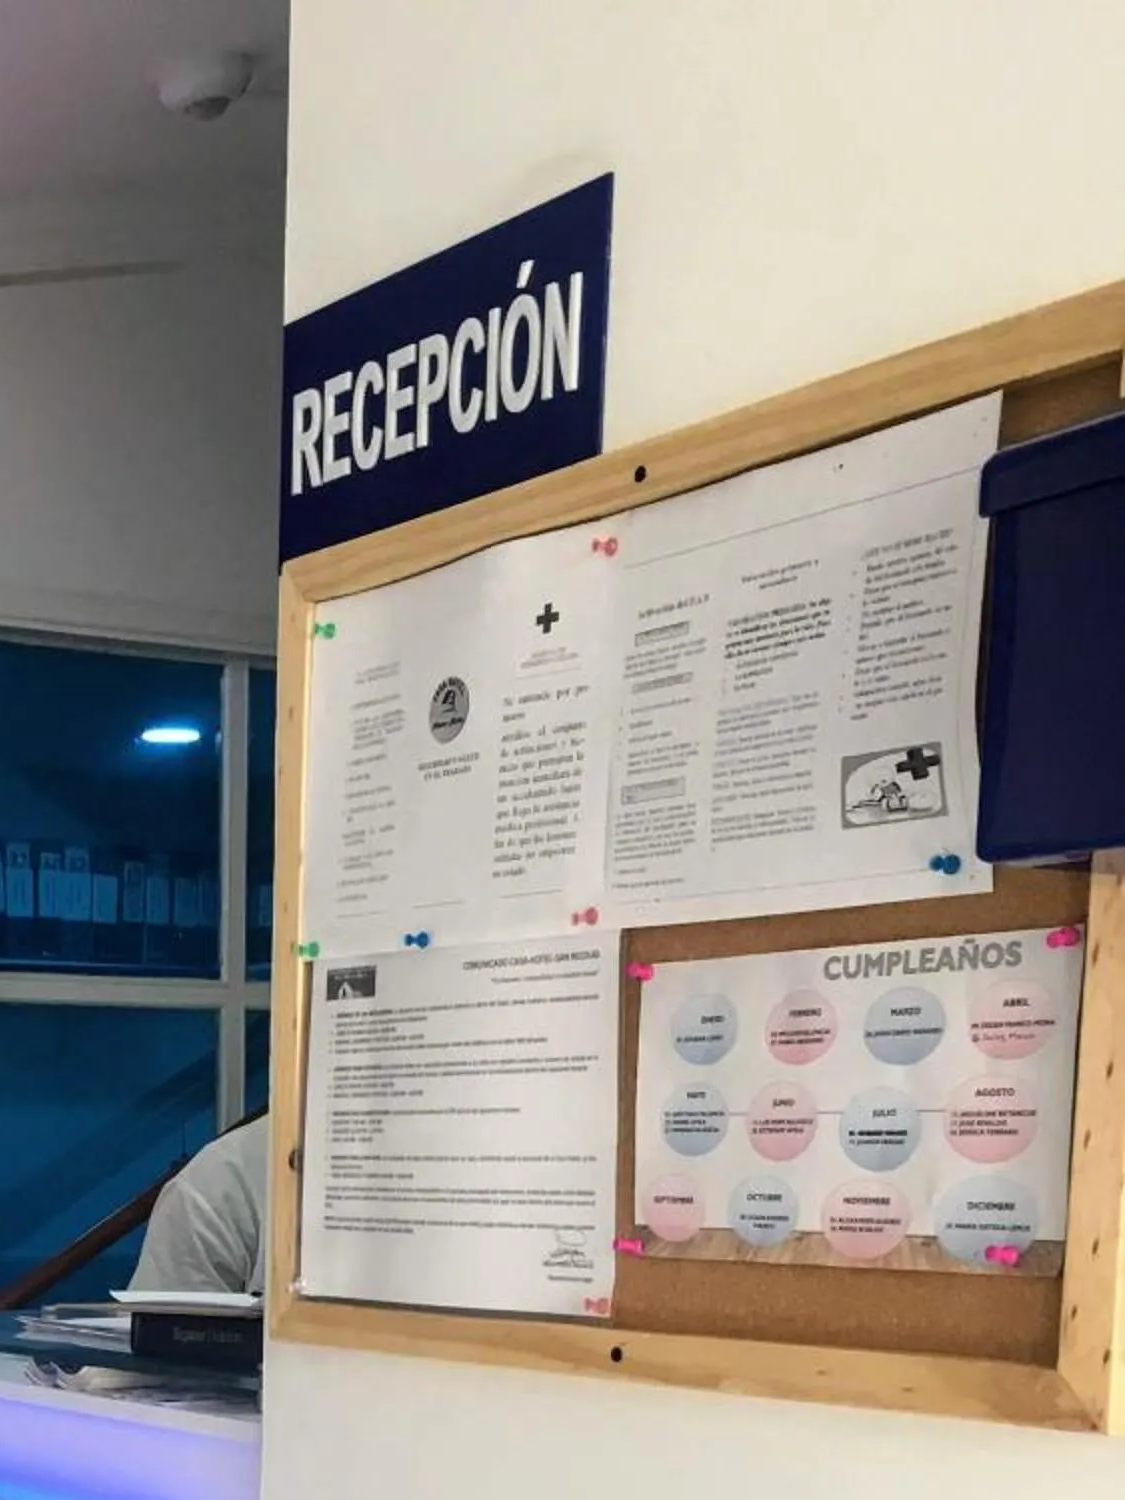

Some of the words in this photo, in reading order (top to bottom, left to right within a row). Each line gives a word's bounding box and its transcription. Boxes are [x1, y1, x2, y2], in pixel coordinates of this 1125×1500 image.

[291, 259, 583, 496] RECEPCIÓN
[823, 938, 1022, 981] CUMPLEAÑOS
[1003, 998, 1030, 1008] ABRIL
[890, 1007, 921, 1017] MARZO
[975, 1087, 1015, 1098] AGOSTO
